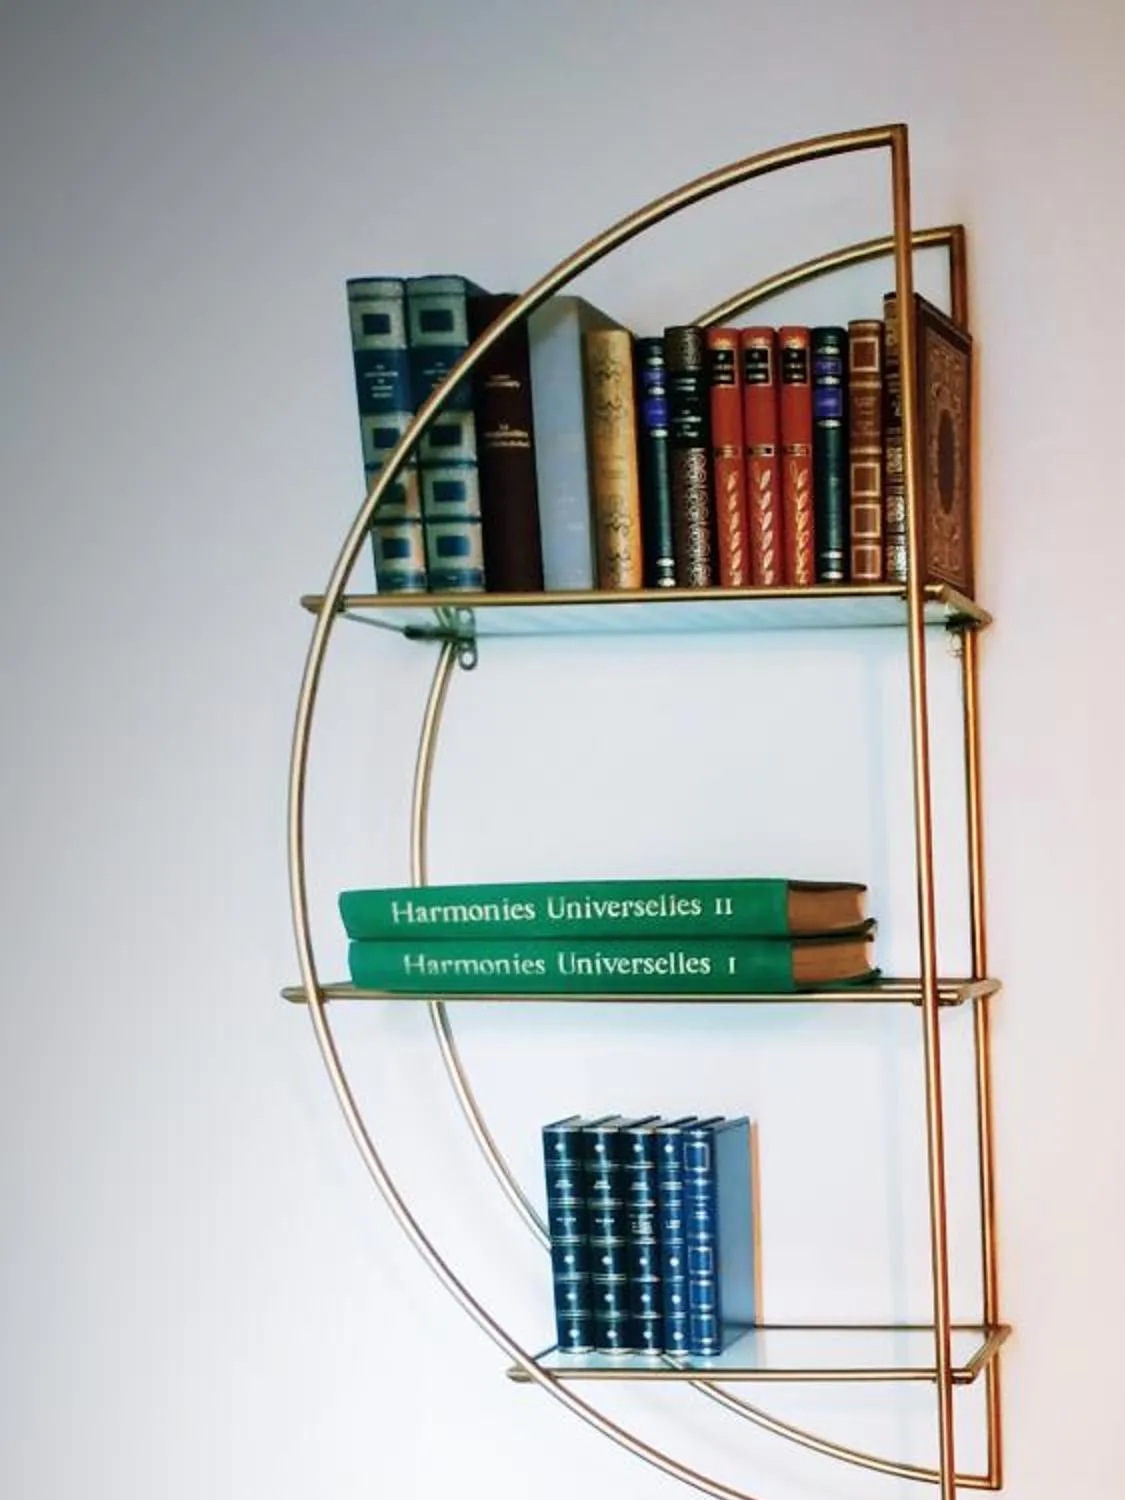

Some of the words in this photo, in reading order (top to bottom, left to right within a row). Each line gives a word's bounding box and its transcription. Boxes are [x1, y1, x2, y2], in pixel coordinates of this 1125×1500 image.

[391, 898, 536, 923] Harmonies
[547, 893, 702, 919] Universelles
[714, 897, 733, 916] II
[403, 953, 546, 975] Harmonies
[557, 951, 711, 975] Universelles
[728, 957, 737, 975] I
